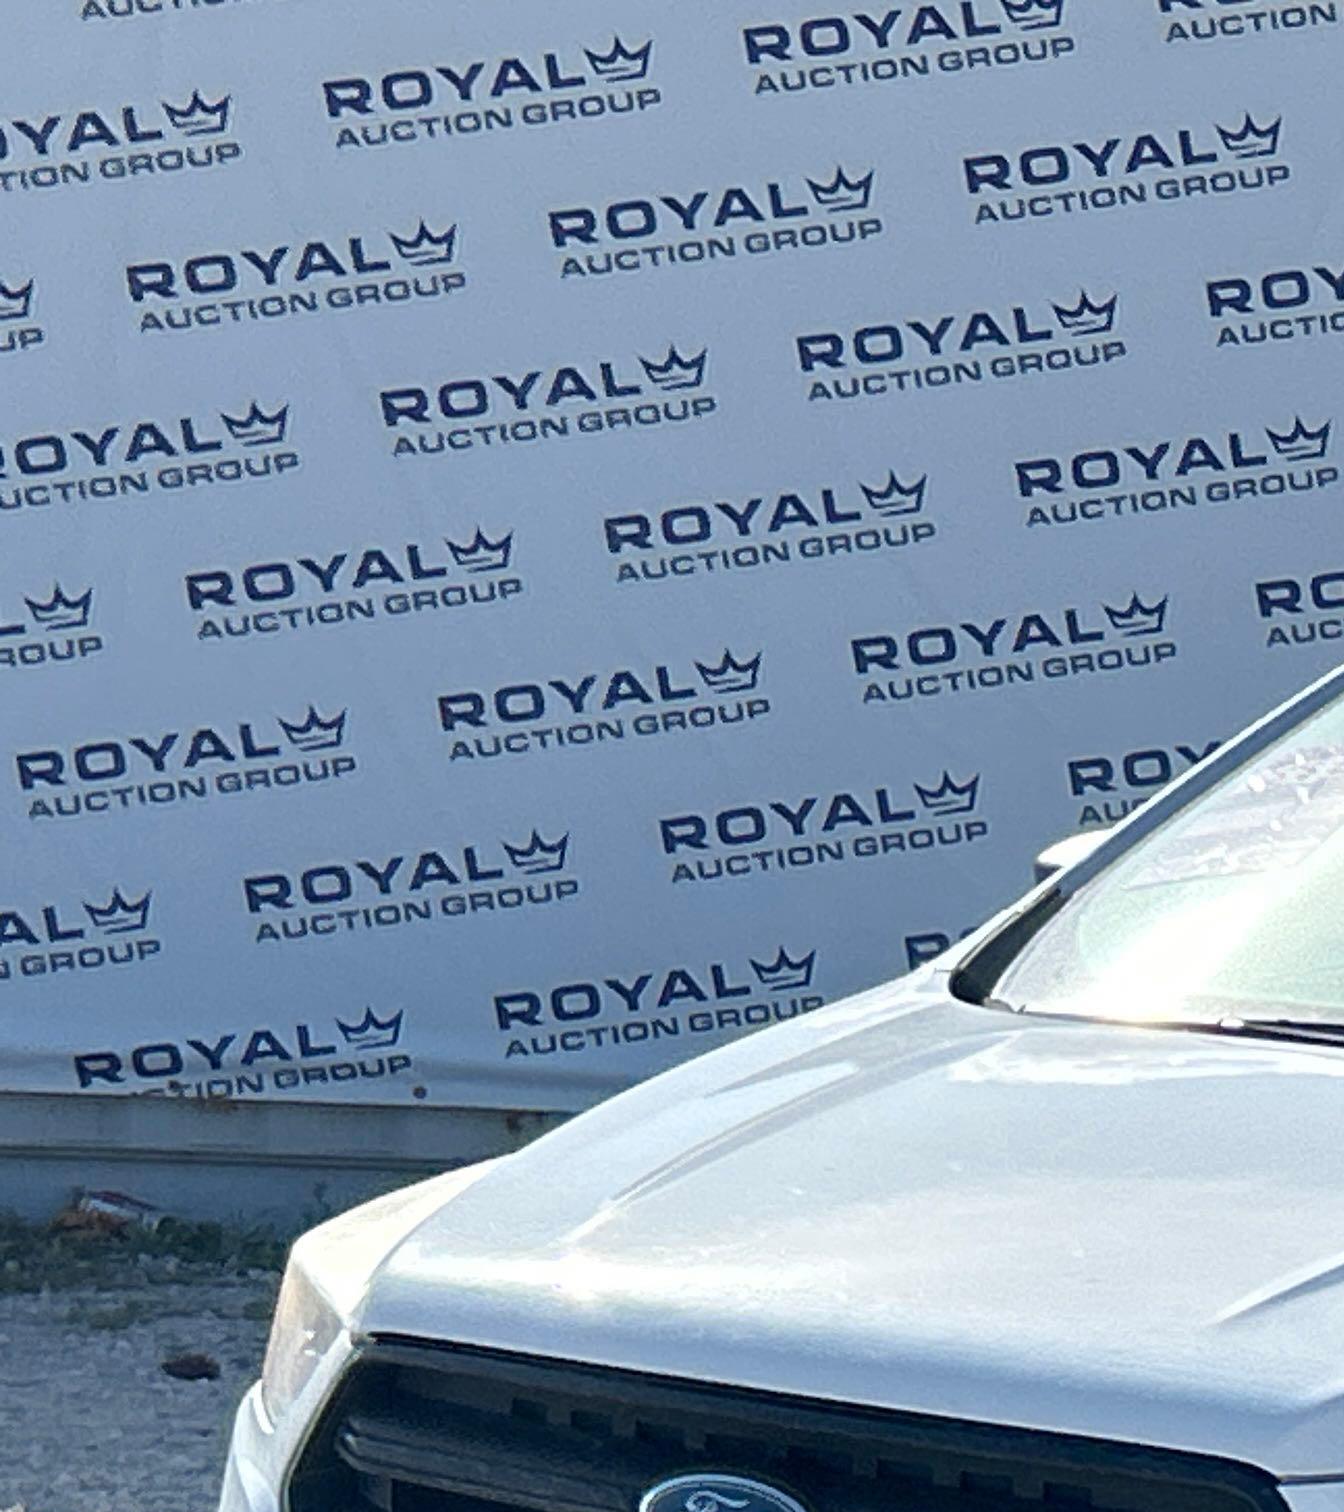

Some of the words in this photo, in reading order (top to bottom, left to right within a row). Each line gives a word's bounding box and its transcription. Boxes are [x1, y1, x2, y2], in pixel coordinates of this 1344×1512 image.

[742, 0, 1001, 64] ROYAL
[1167, 3, 1337, 42] AUCTION
[322, 53, 586, 117] ROYAL
[756, 55, 929, 94] AUCTION
[938, 36, 1075, 72] GROUP
[0, 107, 165, 160] YAL
[336, 108, 513, 148] AUCTION
[522, 89, 661, 125] GROUP
[0, 162, 91, 191] TION
[100, 143, 242, 179] GROUP
[963, 130, 1218, 194] ROYAL
[548, 183, 809, 248] ROYAL
[976, 184, 1147, 223] AUCTION
[1156, 164, 1290, 200] GROUP
[125, 237, 392, 302] ROYAL
[562, 238, 737, 278] AUCTION
[746, 218, 883, 255] GROUP
[140, 292, 318, 332] AUCTION
[327, 272, 468, 309] GROUP
[796, 308, 1053, 372] ROYAL
[809, 362, 981, 401] AUCTION
[990, 341, 1125, 378] GROUP
[379, 362, 641, 427] ROYAL
[0, 418, 222, 482] OYAL
[393, 417, 569, 457] AUCTION
[578, 396, 716, 433] GROUP
[0, 473, 149, 510] UCTION
[158, 452, 299, 490] GROUP
[1014, 433, 1267, 497] ROYAL
[1027, 486, 1197, 526] AUCTION
[1205, 466, 1339, 503] GROUP
[604, 489, 862, 554] ROYAL
[617, 542, 790, 583] AUCTION
[799, 522, 936, 559] GROUP
[184, 544, 448, 610] ROYAL
[198, 599, 375, 639] AUCTION
[384, 578, 523, 615] GROUP
[0, 636, 103, 669] ROUP
[850, 609, 1105, 674] ROYAL
[863, 662, 1034, 703] AUCTION
[1043, 641, 1177, 678] GROUP
[436, 666, 697, 731] ROYAL
[450, 719, 625, 760] AUCTION
[634, 698, 771, 736] GROUP
[15, 723, 281, 789] ROYAL
[1067, 741, 1221, 796] ROY
[29, 777, 207, 819] AUCTION
[216, 756, 356, 794] GROUP
[659, 788, 916, 853] ROYAL
[672, 841, 844, 882] AUCTION
[853, 820, 988, 857] GROUP
[242, 847, 504, 913] ROYAL
[256, 900, 432, 942] AUCTION
[441, 879, 579, 916] GROUP
[21, 939, 162, 977] GROUP
[493, 964, 751, 1030] ROYAL
[506, 1017, 680, 1058] AUCTION
[688, 995, 824, 1033] GROUP
[73, 1022, 337, 1089] ROYAL
[141, 1076, 264, 1099] TION
[273, 1054, 412, 1092] GROUP
